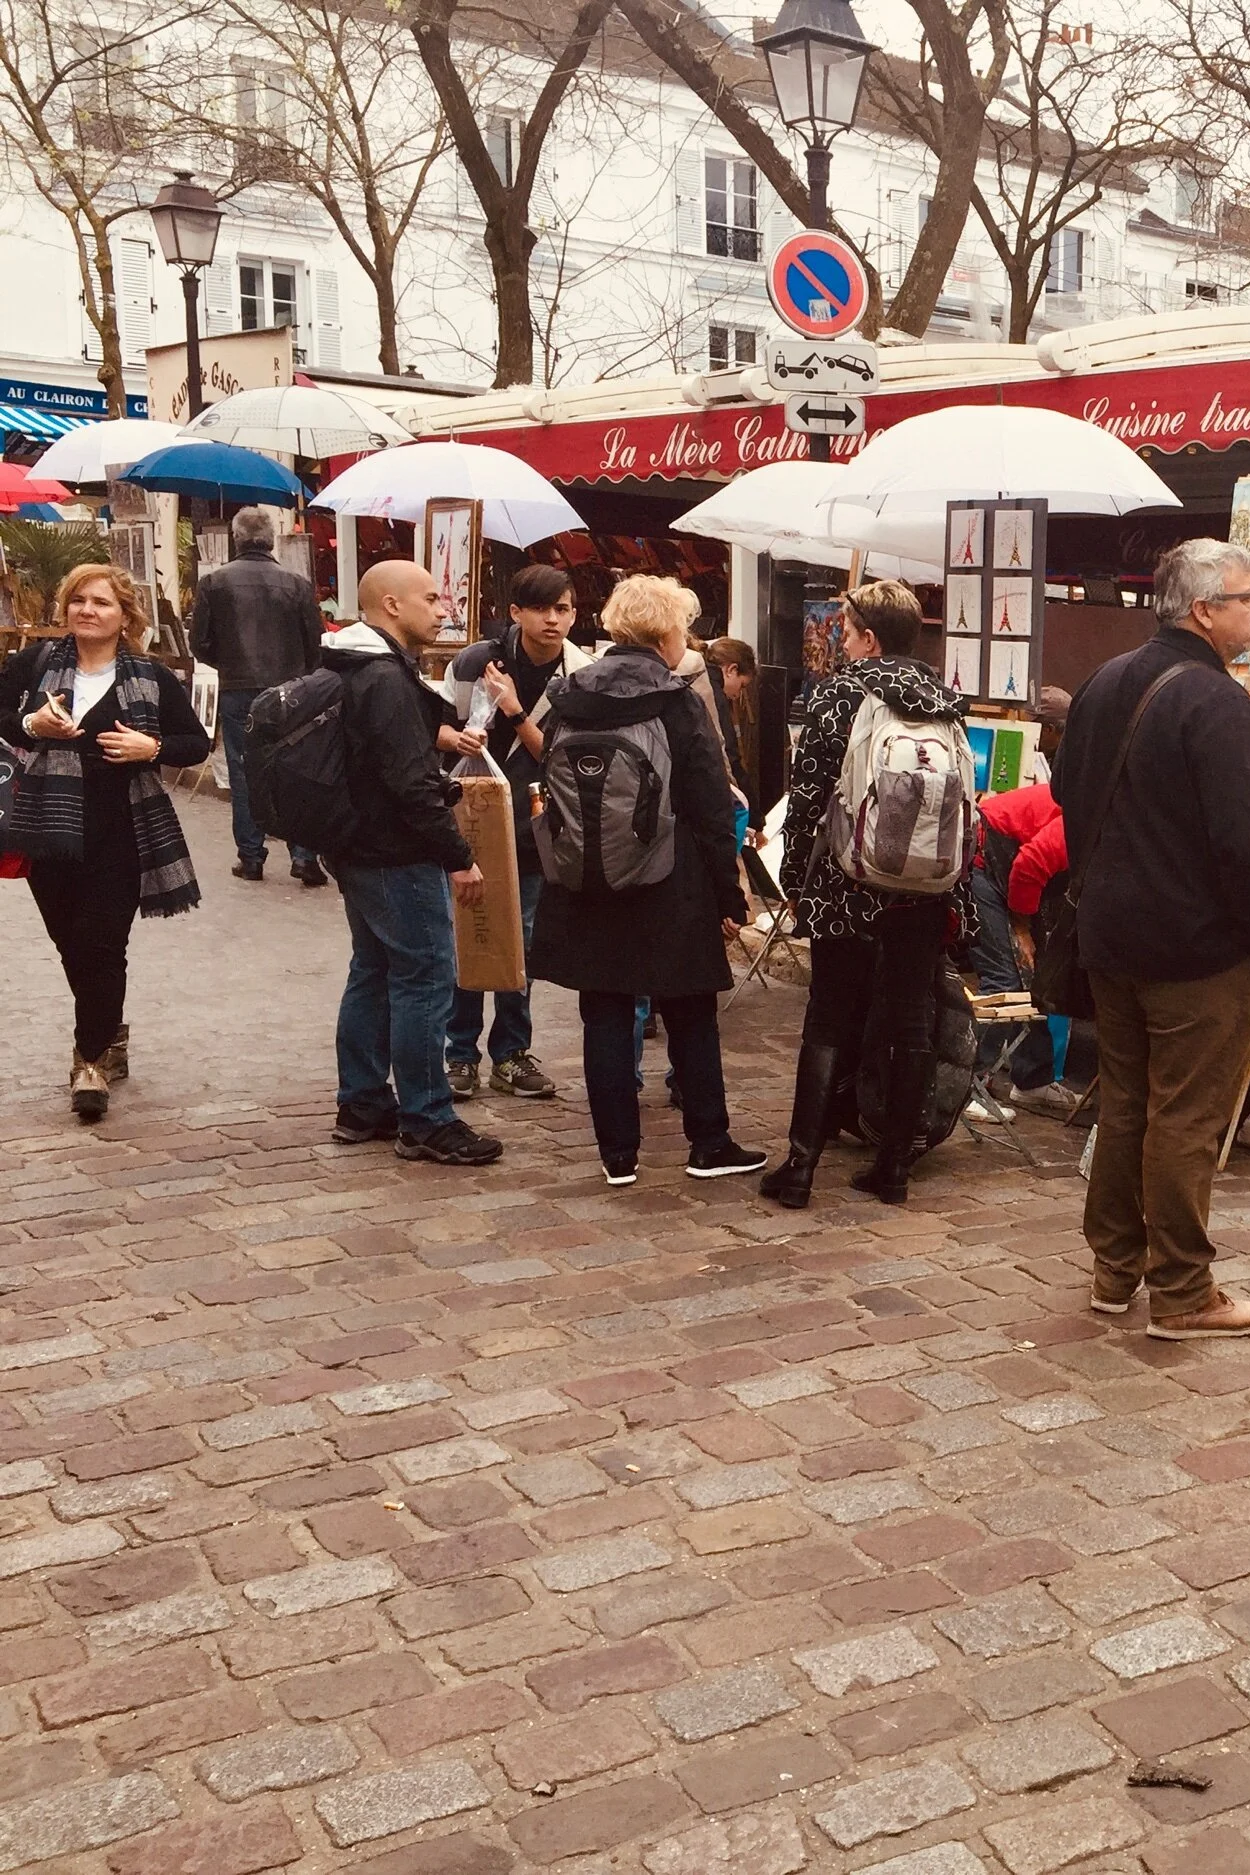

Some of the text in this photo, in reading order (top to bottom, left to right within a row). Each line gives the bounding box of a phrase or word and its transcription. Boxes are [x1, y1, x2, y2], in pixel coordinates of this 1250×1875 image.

[7, 387, 26, 399] AU
[33, 391, 94, 408] CLAIRON
[1082, 396, 1187, 439] Cuisine
[599, 427, 637, 470] La
[649, 423, 722, 467] Mère
